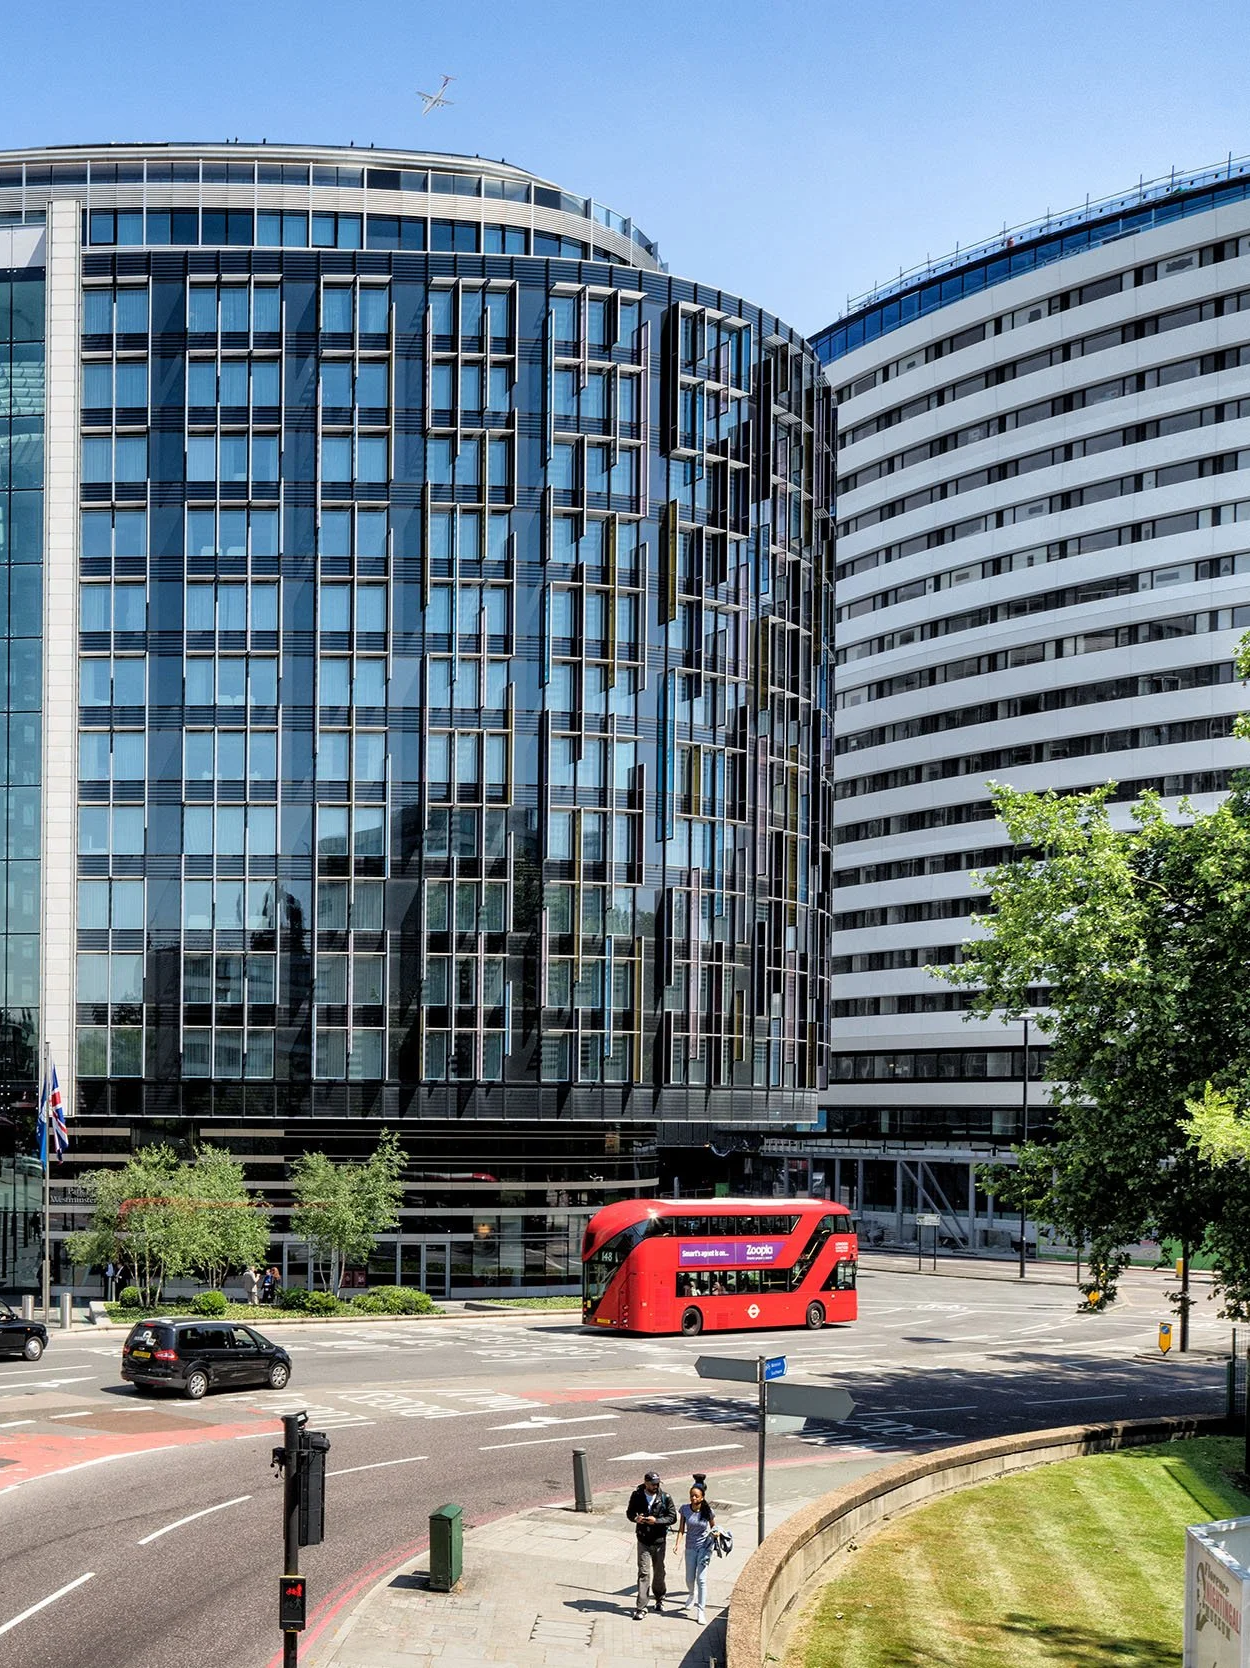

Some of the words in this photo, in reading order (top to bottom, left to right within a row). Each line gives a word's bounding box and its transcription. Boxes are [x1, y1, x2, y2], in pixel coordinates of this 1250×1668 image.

[601, 1250, 613, 1262] 148
[746, 1244, 774, 1257] Zoopla
[338, 1392, 461, 1418] BUSES
